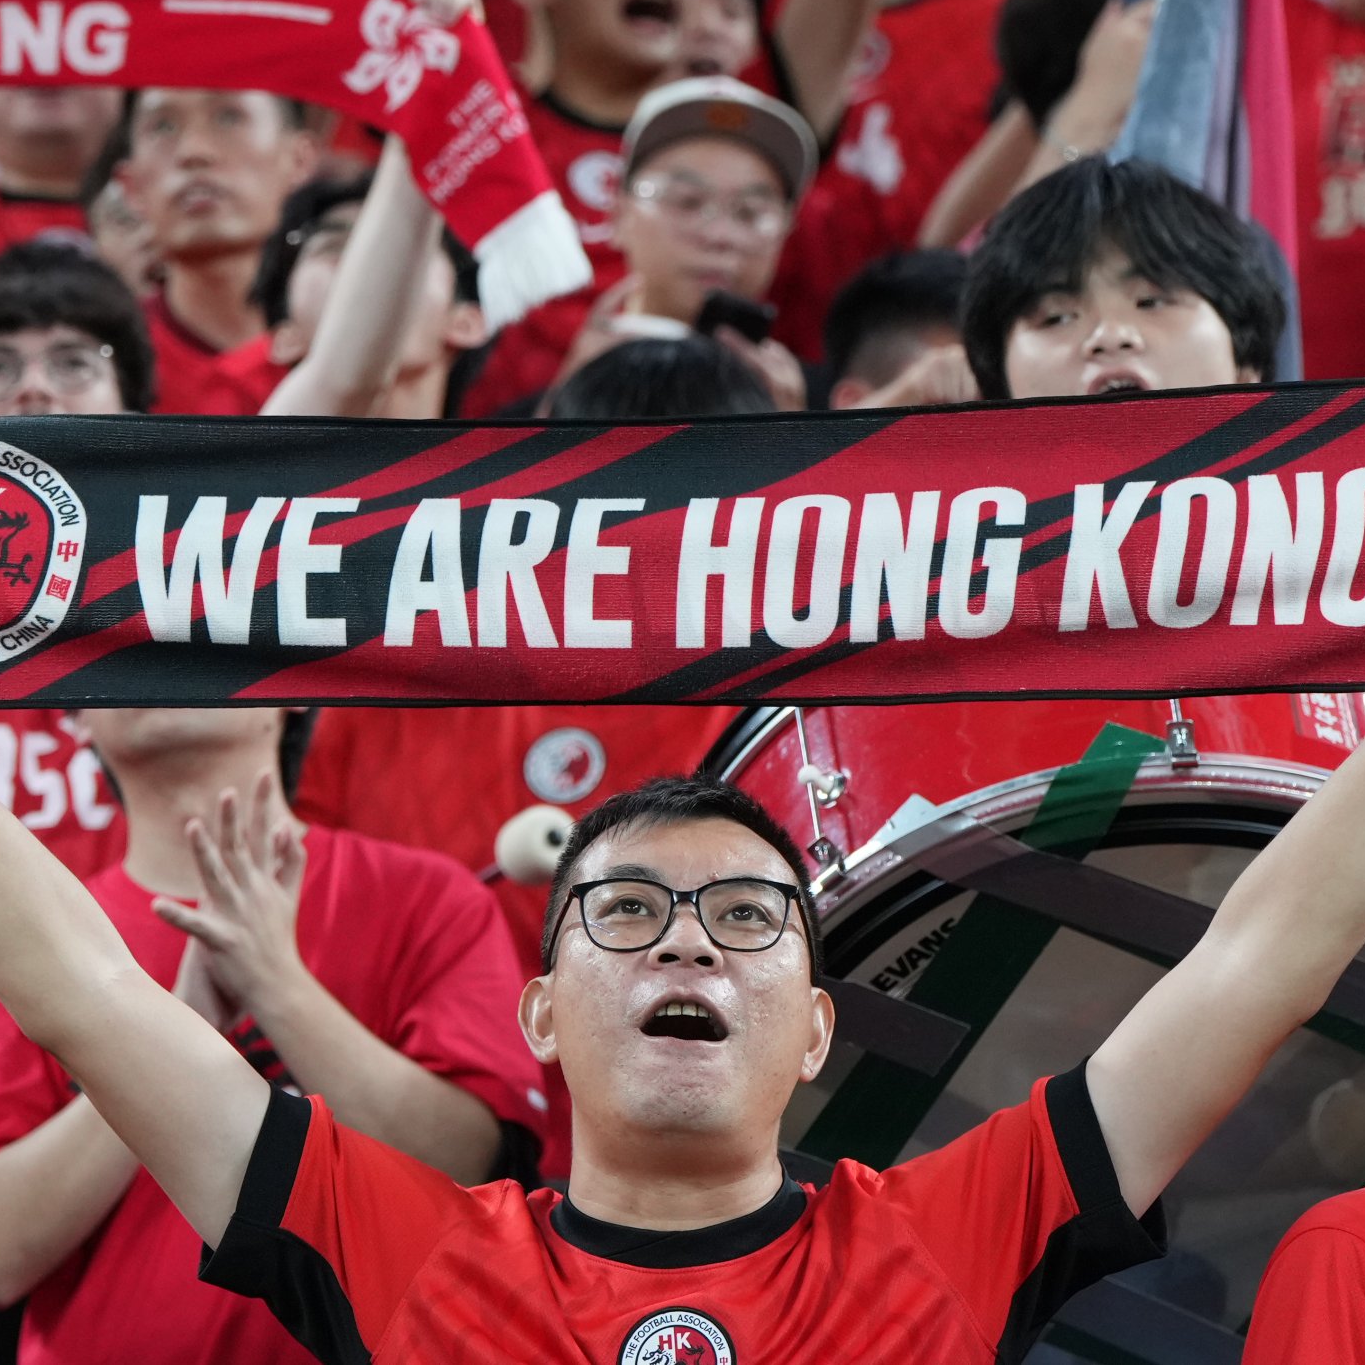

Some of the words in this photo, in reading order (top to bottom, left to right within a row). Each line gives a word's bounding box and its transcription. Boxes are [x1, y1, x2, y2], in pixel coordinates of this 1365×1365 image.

[46, 540, 80, 602] 中國
[135, 494, 361, 646] WE
[384, 496, 646, 649] ARE
[674, 485, 1027, 650] HONG
[0, 613, 55, 651] CHINA
[626, 1342, 638, 1359] THE
[635, 1315, 675, 1343] FOOTBALL
[676, 1314, 726, 1351] ASSOCIATION
[659, 1332, 692, 1350] HK
